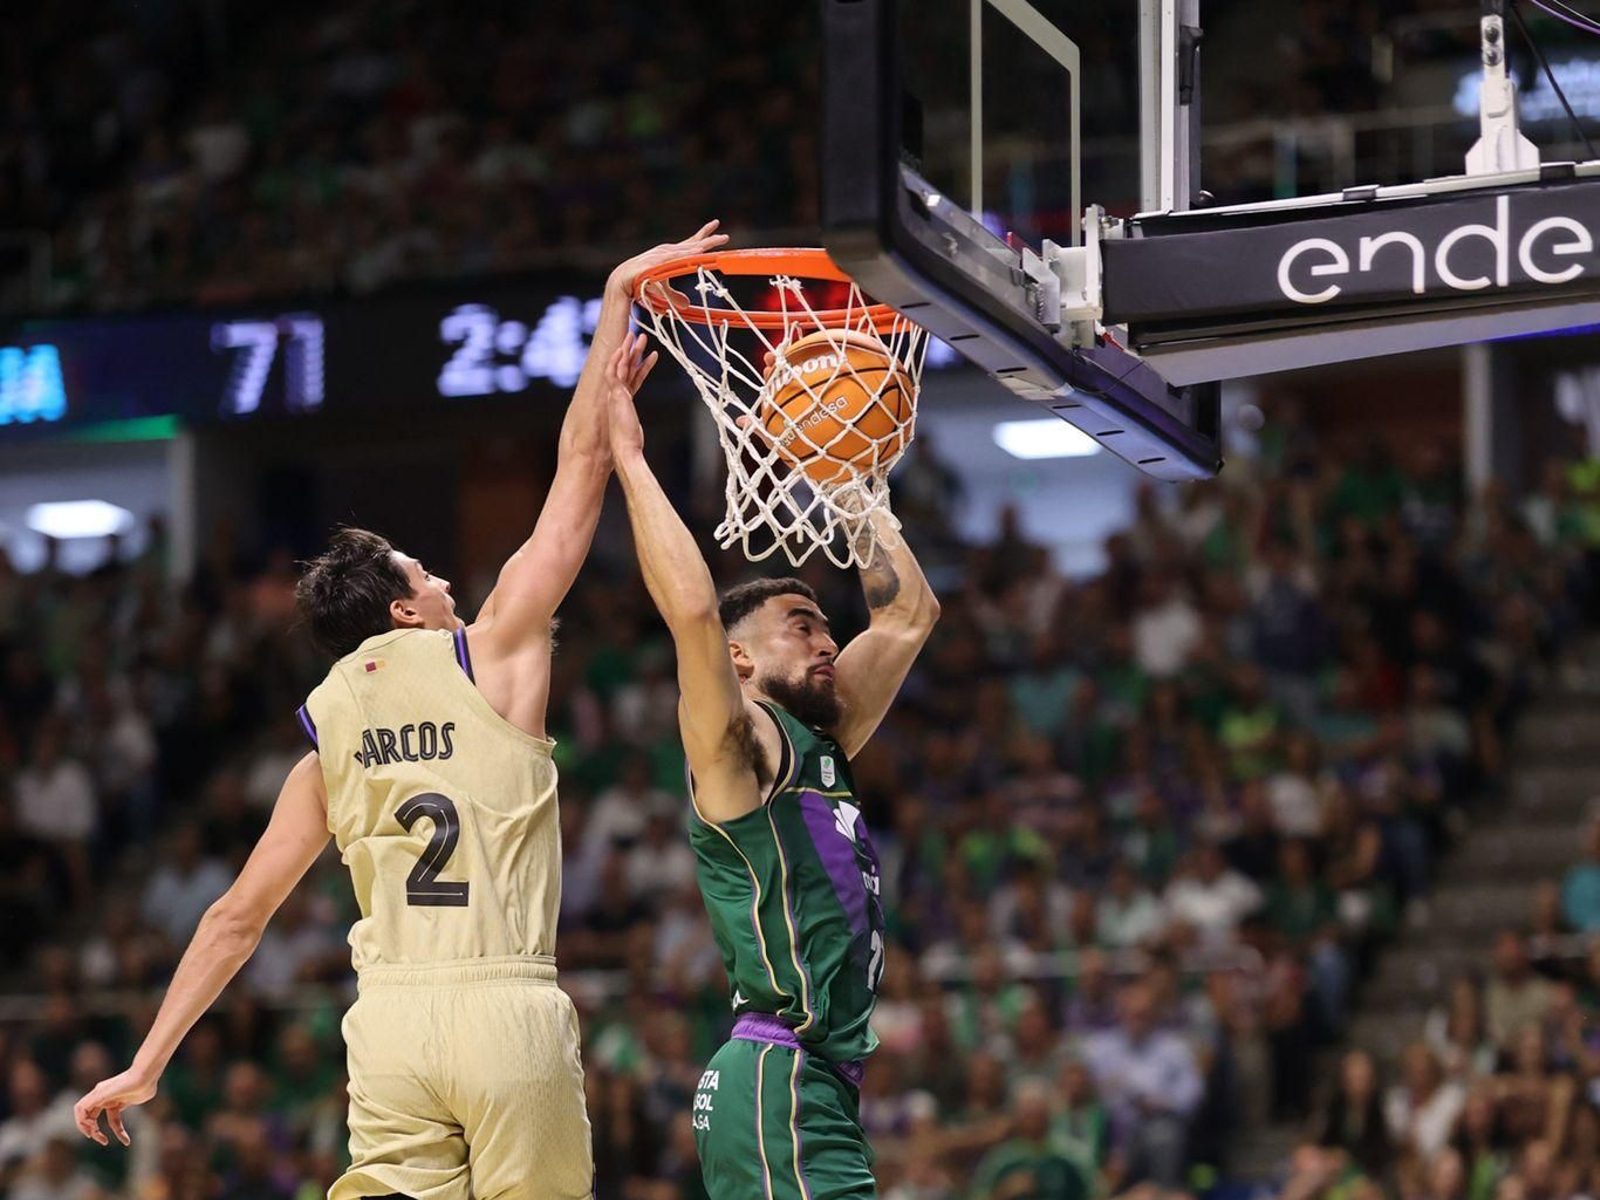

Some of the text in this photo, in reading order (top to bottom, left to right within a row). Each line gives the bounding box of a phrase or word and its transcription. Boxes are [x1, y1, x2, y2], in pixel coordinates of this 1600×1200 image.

[1277, 195, 1594, 304] ende
[212, 312, 325, 415] 71
[437, 296, 632, 397] 2:4
[394, 792, 469, 907] 2
